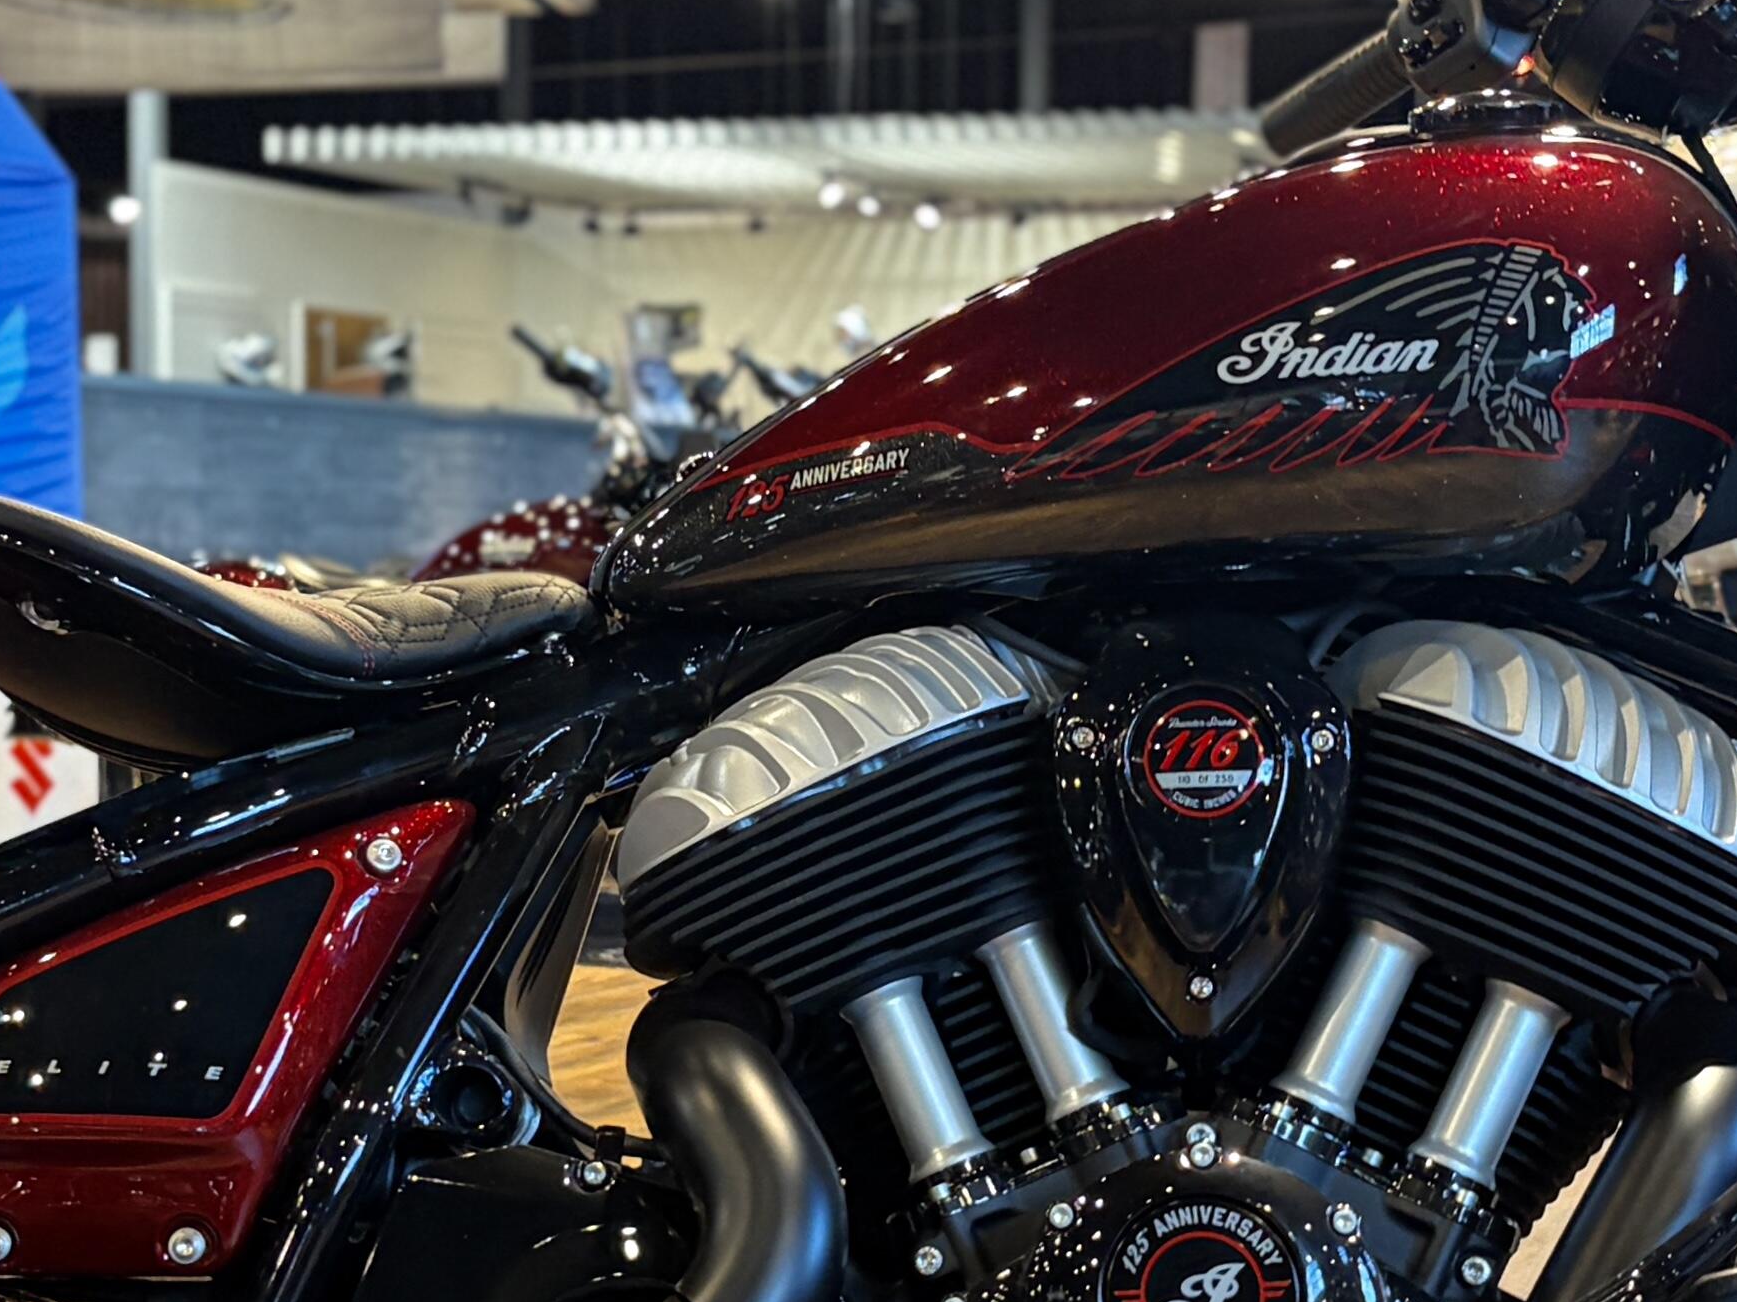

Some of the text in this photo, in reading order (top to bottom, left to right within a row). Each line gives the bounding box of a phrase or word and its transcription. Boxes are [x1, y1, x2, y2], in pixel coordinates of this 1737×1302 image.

[1217, 321, 1440, 385] Indian
[726, 447, 910, 522] 125 ANNIVERSARY
[1160, 729, 1244, 770] 116
[1172, 789, 1238, 810] CUBIC INCHES
[1121, 1204, 1284, 1276] 125 ANNIVERSARY
